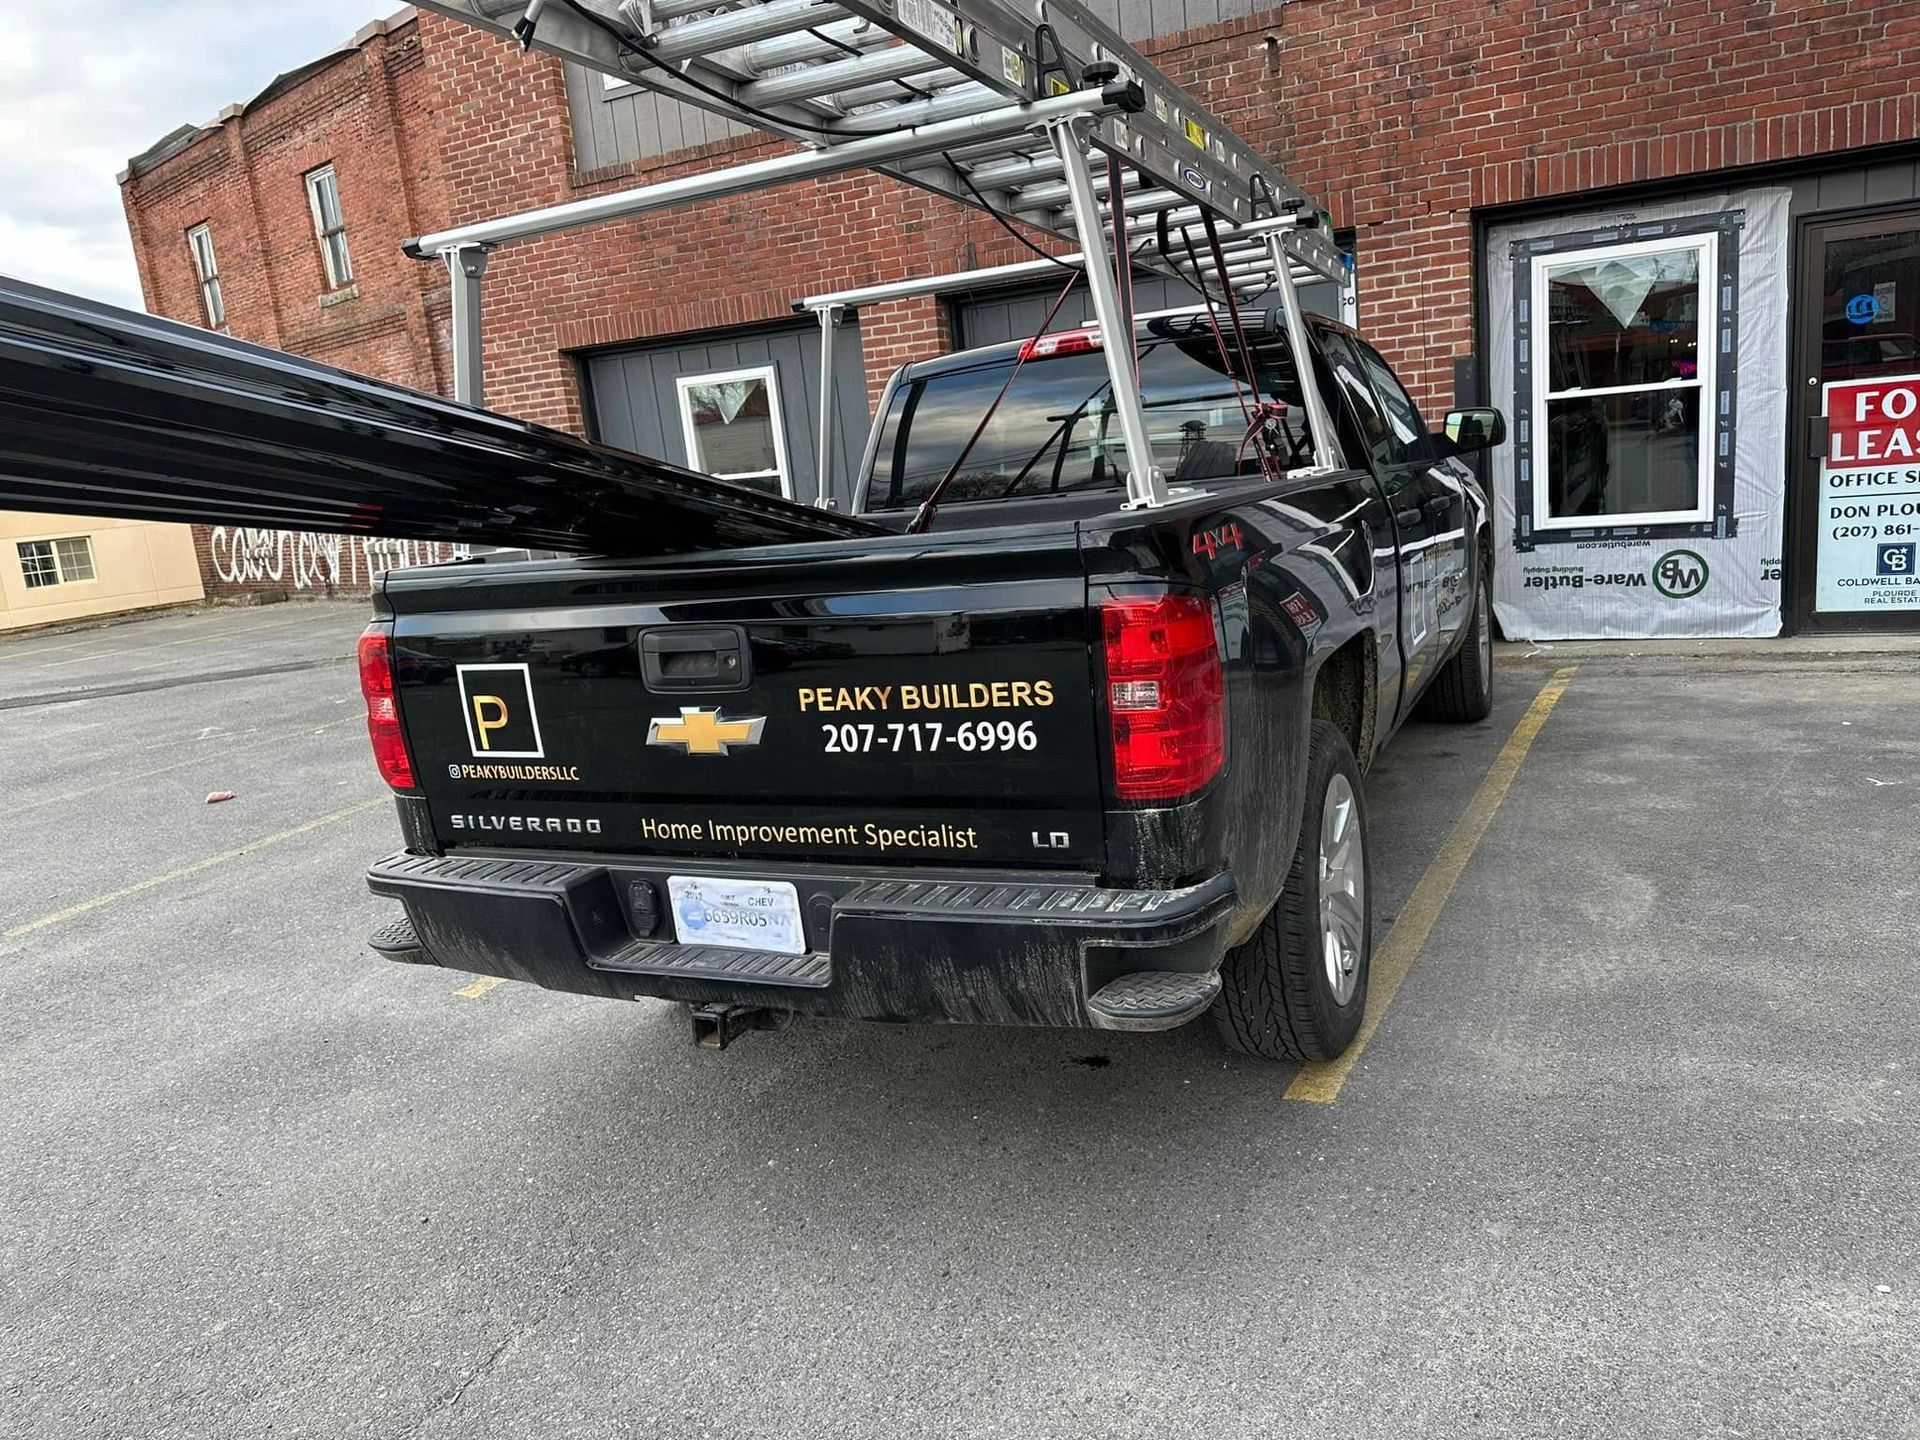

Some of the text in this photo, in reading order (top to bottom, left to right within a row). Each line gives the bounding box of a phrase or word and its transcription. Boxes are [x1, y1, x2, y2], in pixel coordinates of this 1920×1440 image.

[1832, 427, 1920, 462] LEA
[1829, 470, 1920, 488] OFFICE S
[1830, 505, 1870, 519] DON
[1832, 525, 1877, 541] (207)
[1523, 573, 1648, 591] Ware-Butler
[1837, 577, 1902, 587] COLDWELL
[1864, 597, 1889, 605] REAL
[1872, 590, 1916, 598] PLOURDE
[798, 680, 1055, 713] PEAKY BUILDERS
[473, 695, 509, 749] P
[822, 720, 1038, 753] 207-717-6996
[461, 764, 580, 781] PEAKYBUILDERSLLC
[450, 814, 602, 834] SILVERADO
[641, 818, 978, 851] Home Improvement Specialist
[1031, 830, 1072, 849] LD
[748, 897, 775, 908] CHEV
